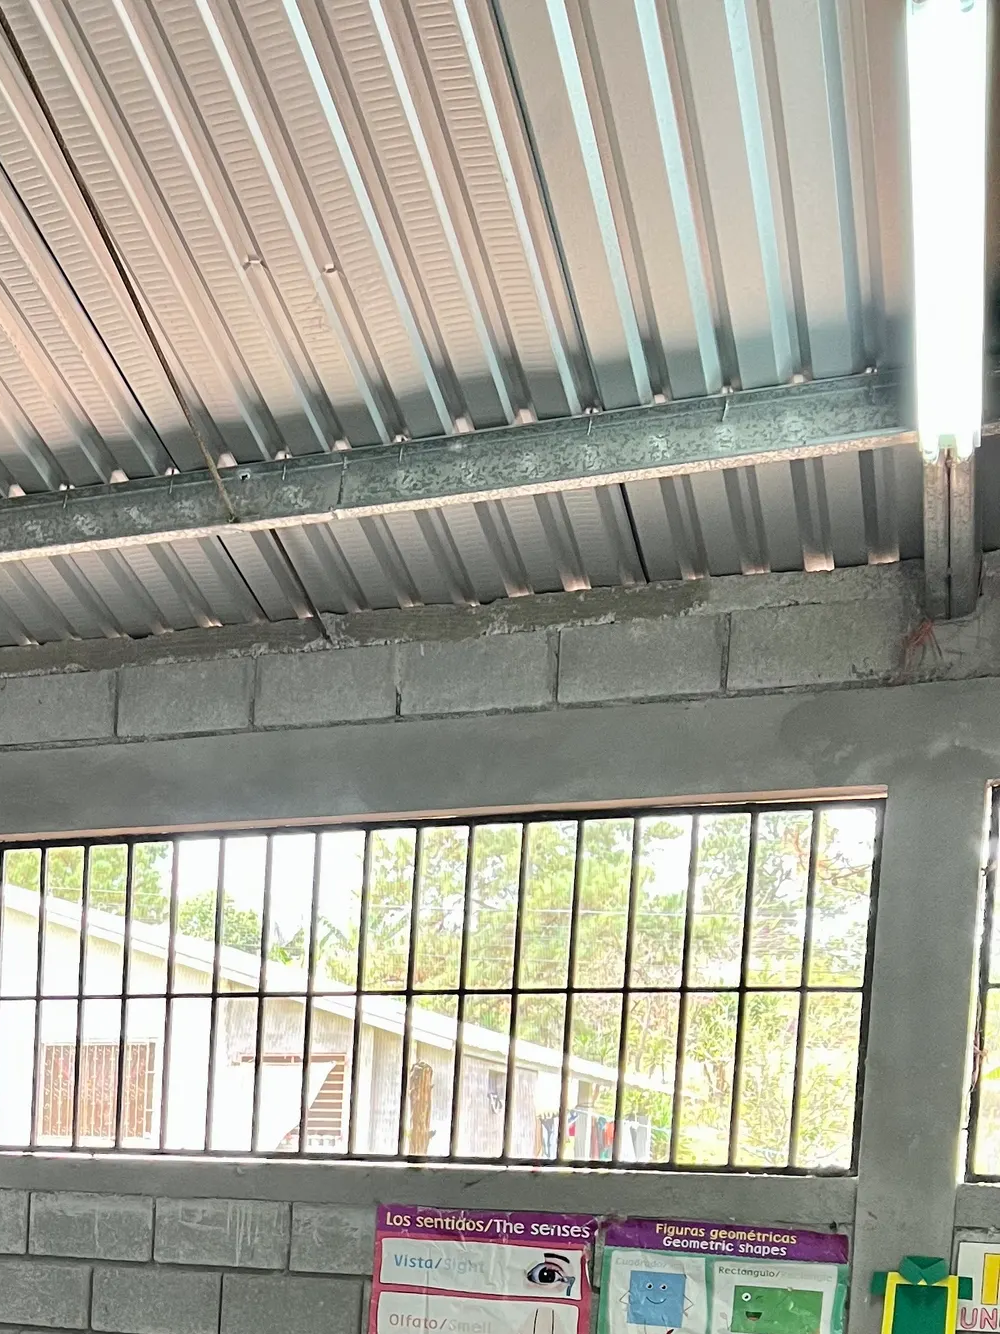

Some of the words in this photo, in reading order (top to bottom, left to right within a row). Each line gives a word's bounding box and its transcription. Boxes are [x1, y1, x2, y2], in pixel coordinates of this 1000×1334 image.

[386, 1211, 411, 1227] Los
[530, 1222, 591, 1239] senses
[656, 1223, 705, 1237] Figuras
[710, 1226, 797, 1244] geométricas
[662, 1236, 734, 1252] Geometric
[738, 1242, 788, 1257] shapes
[960, 1306, 1000, 1329] UN
